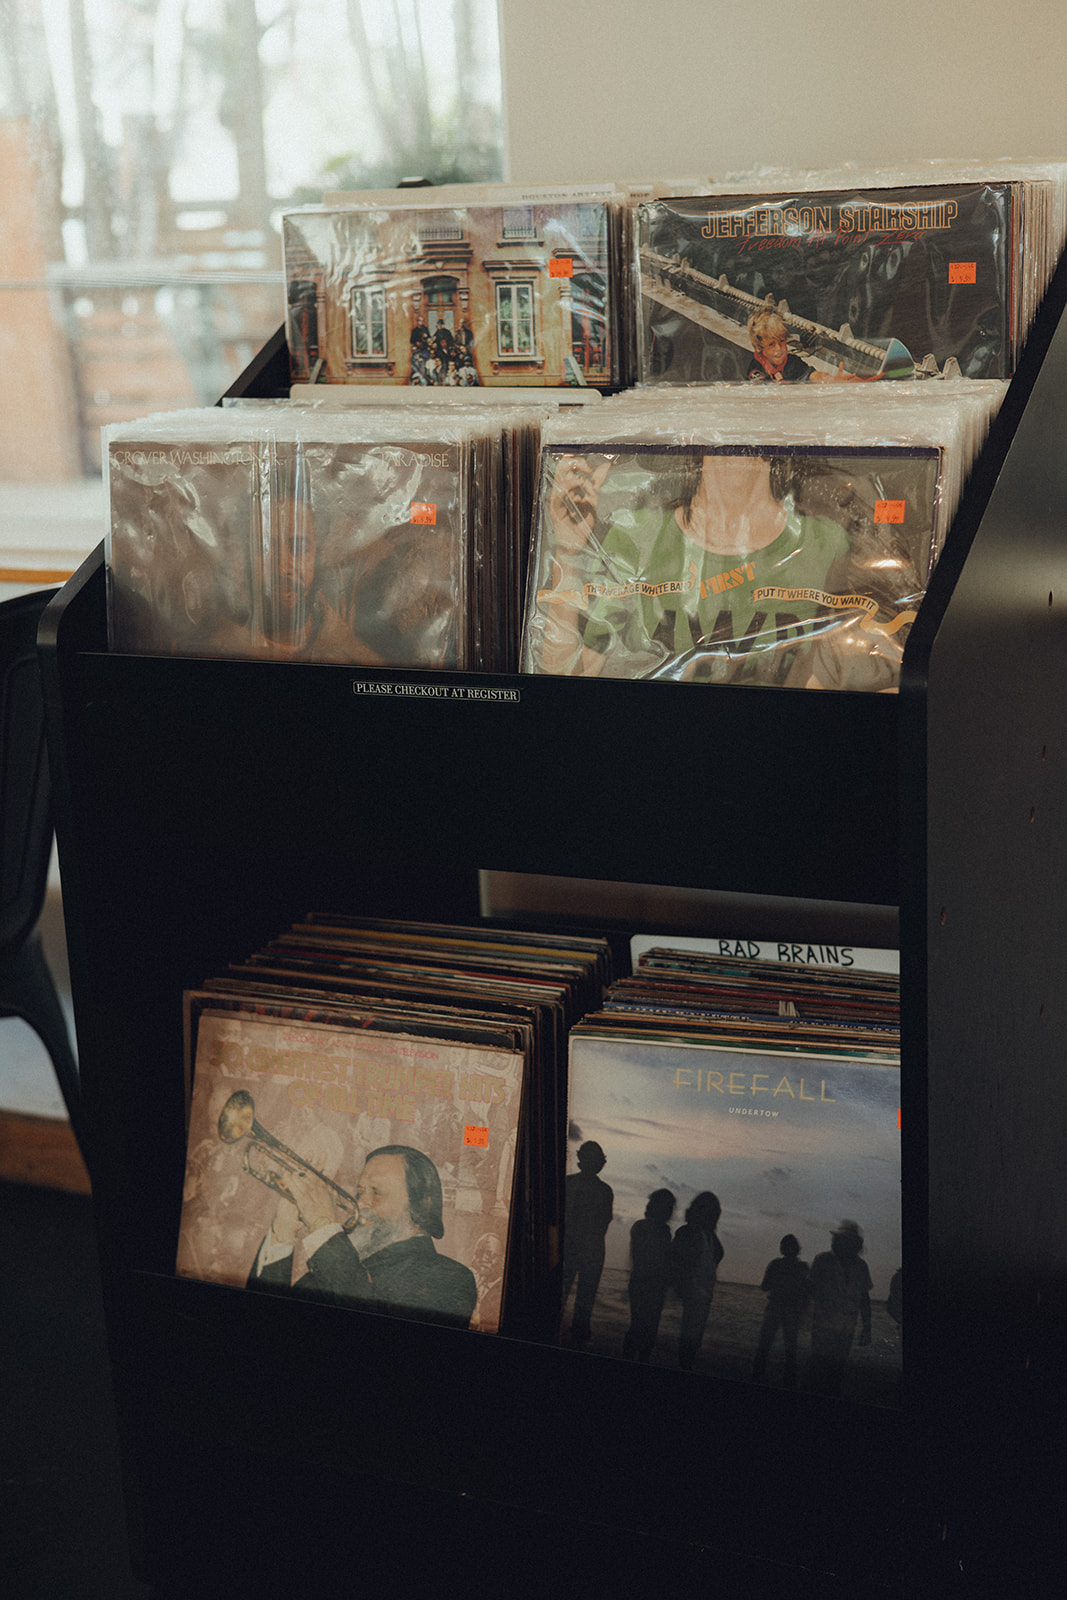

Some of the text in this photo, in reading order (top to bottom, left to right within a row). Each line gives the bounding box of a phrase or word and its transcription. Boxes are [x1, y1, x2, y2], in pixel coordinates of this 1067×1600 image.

[701, 200, 959, 239] JEFFERSON STARSHIP
[731, 225, 929, 255] Freedom At Point Zero
[113, 450, 169, 466] GROVER
[381, 452, 450, 468] PARADISE
[586, 584, 603, 594] THE
[603, 583, 640, 597] AVERAGE
[641, 583, 669, 597] WHITE
[700, 561, 757, 600] FIRST
[757, 588, 877, 611] PUT IT WHERE YOU WANT IT
[356, 683, 518, 701] PLEASE CHECKOUT AT REGISTER
[718, 940, 855, 967] BAD BRAINS
[246, 1045, 353, 1083] GREATEST
[353, 1059, 456, 1098] TRUMPET
[458, 1072, 507, 1105] HITS
[672, 1067, 836, 1102] FIREFALL
[287, 1079, 417, 1123] OF ALL TIME
[728, 1106, 779, 1119] UNDERTOW
